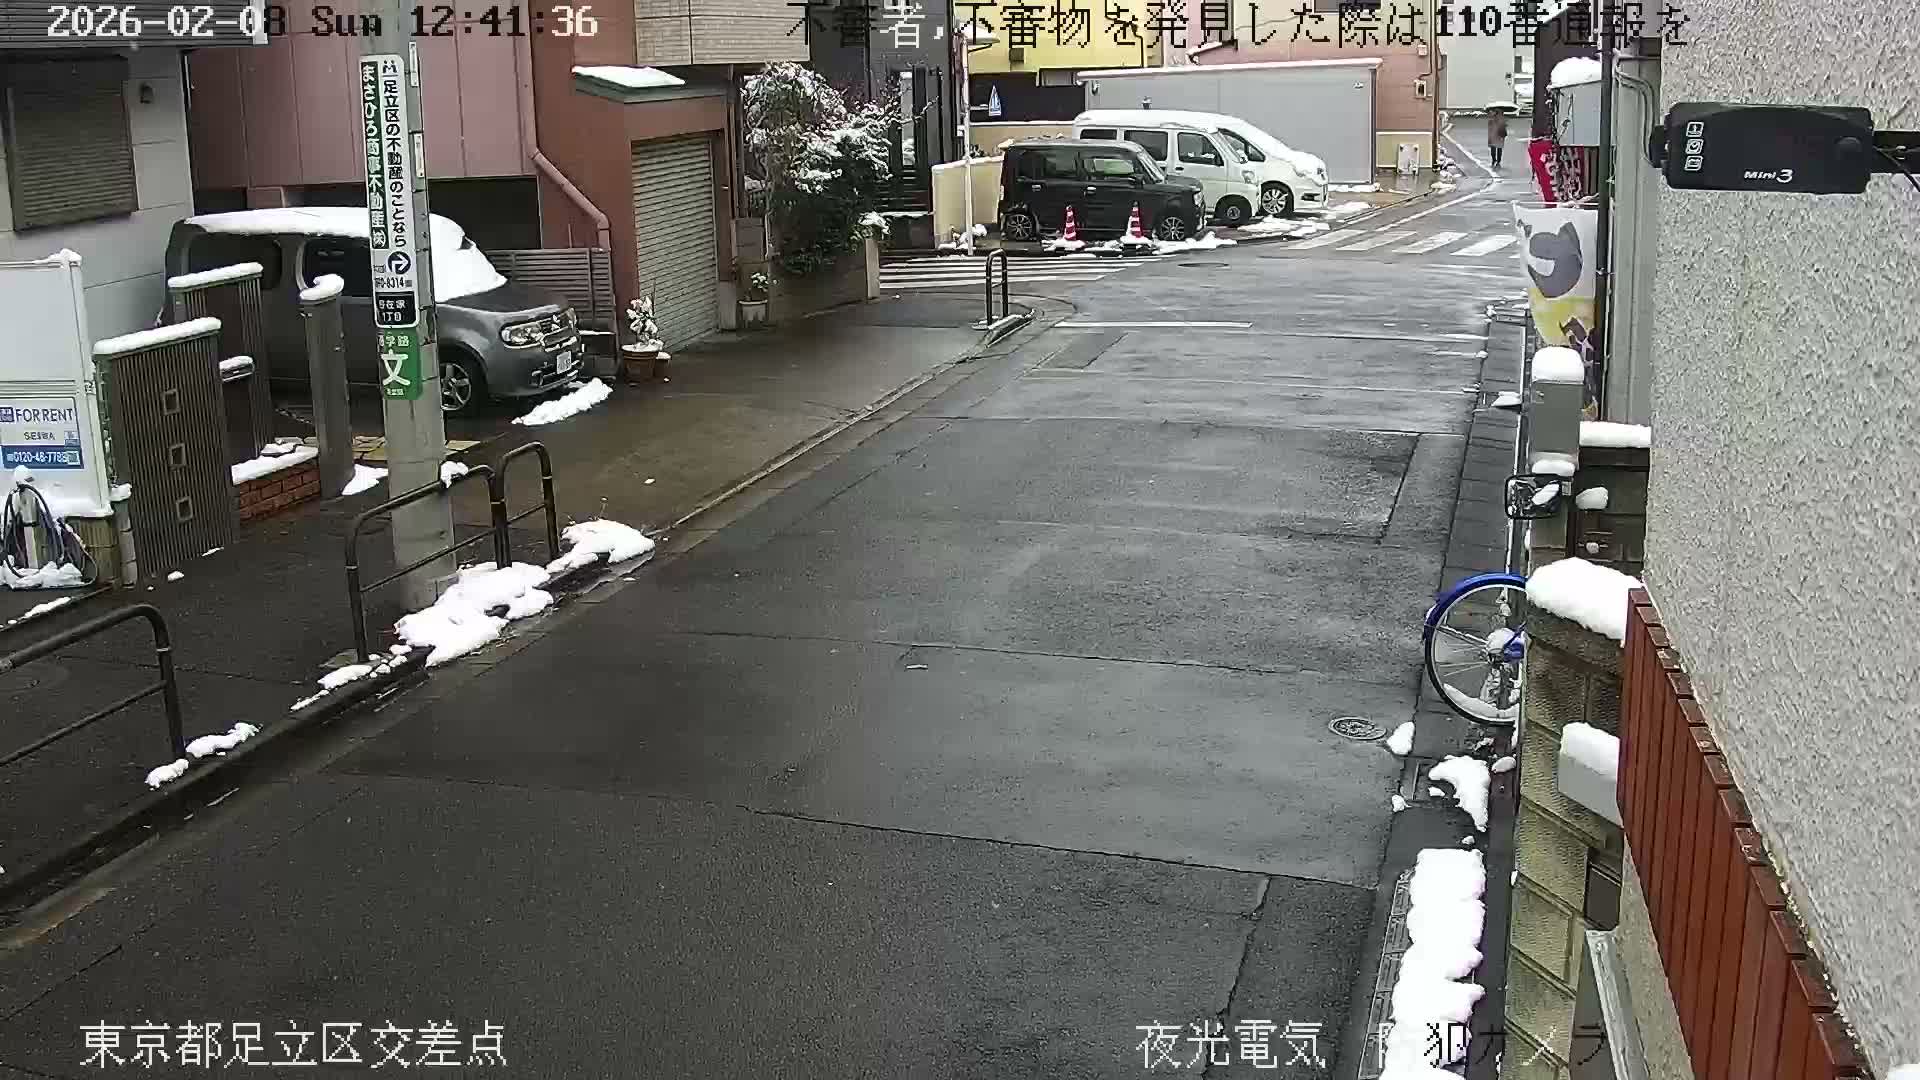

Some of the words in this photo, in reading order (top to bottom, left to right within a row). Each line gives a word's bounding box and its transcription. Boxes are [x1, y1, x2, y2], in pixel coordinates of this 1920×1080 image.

[382, 79, 407, 247] 足立区の不動産のことなら
[380, 348, 411, 386] 文
[15, 408, 40, 422] FOR
[42, 408, 73, 422] RENT
